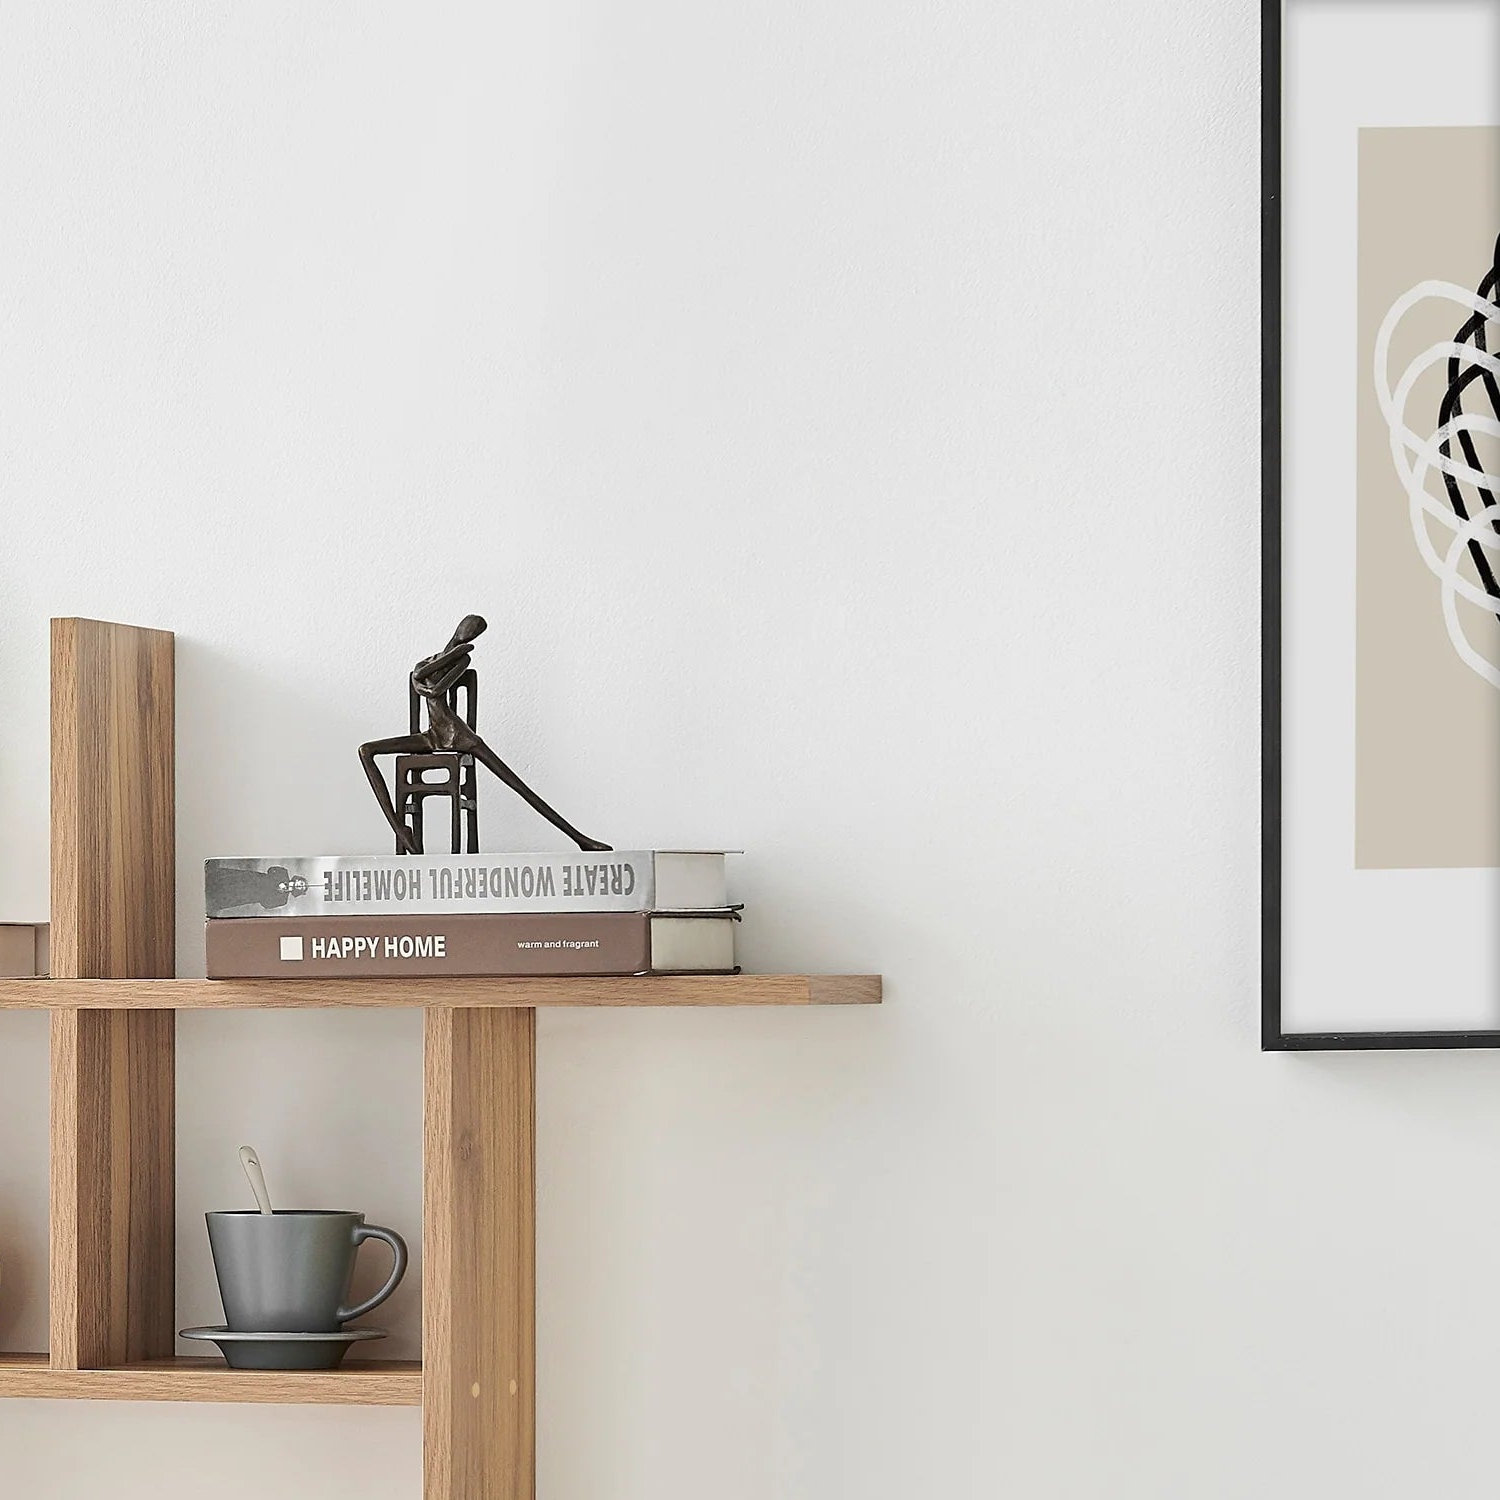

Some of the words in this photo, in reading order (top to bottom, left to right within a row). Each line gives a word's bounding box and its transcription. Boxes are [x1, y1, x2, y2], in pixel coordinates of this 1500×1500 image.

[323, 868, 422, 902] HOMELIFE
[429, 866, 556, 899] WONDERFUL
[563, 863, 635, 897] CREATE
[312, 936, 380, 959] HAPPY
[384, 935, 446, 958] HOME
[517, 941, 543, 949] warm
[543, 939, 562, 949] and
[562, 939, 599, 951] fragrant
